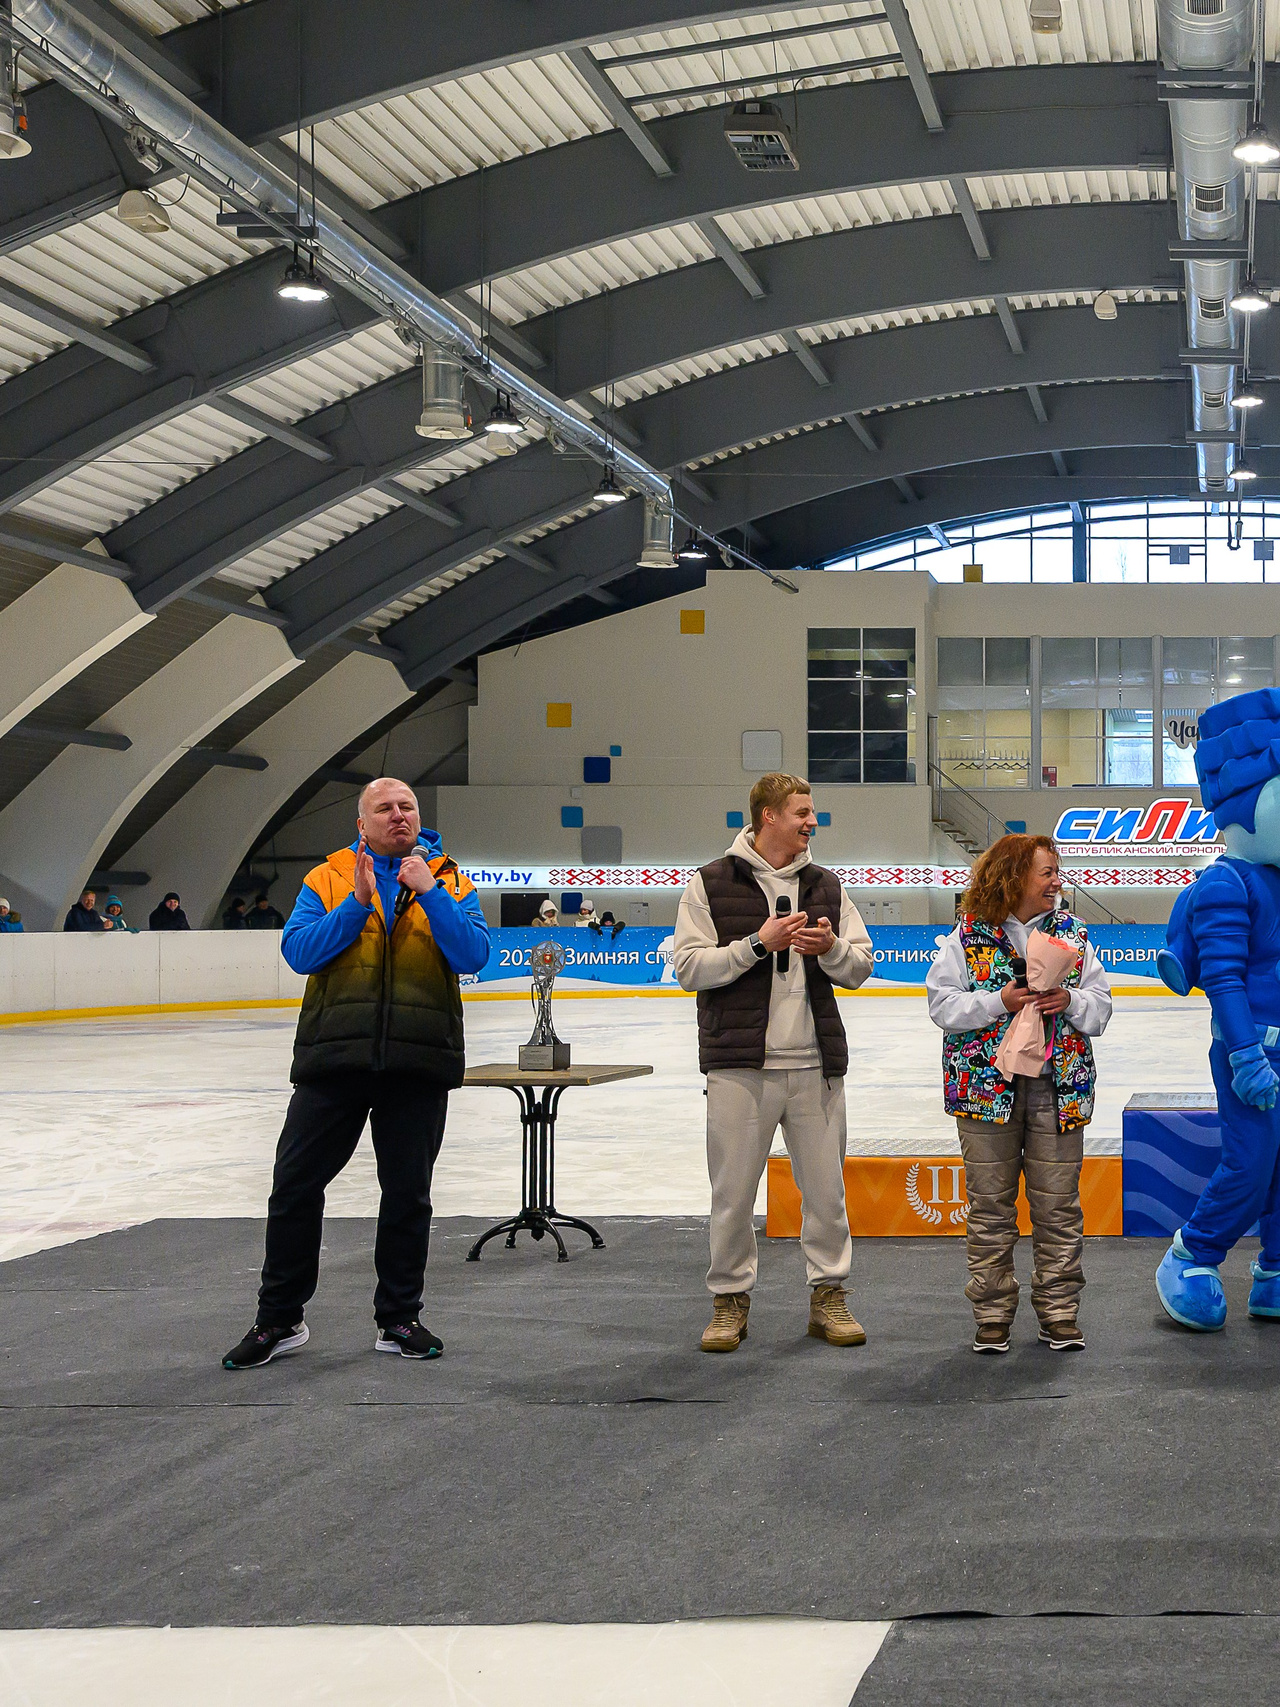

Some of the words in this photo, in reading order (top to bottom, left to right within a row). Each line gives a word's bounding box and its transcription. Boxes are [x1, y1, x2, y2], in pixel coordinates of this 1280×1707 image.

[564, 947, 640, 966] Зимняя
[1094, 944, 1166, 966] правл
[926, 1165, 965, 1204] II
